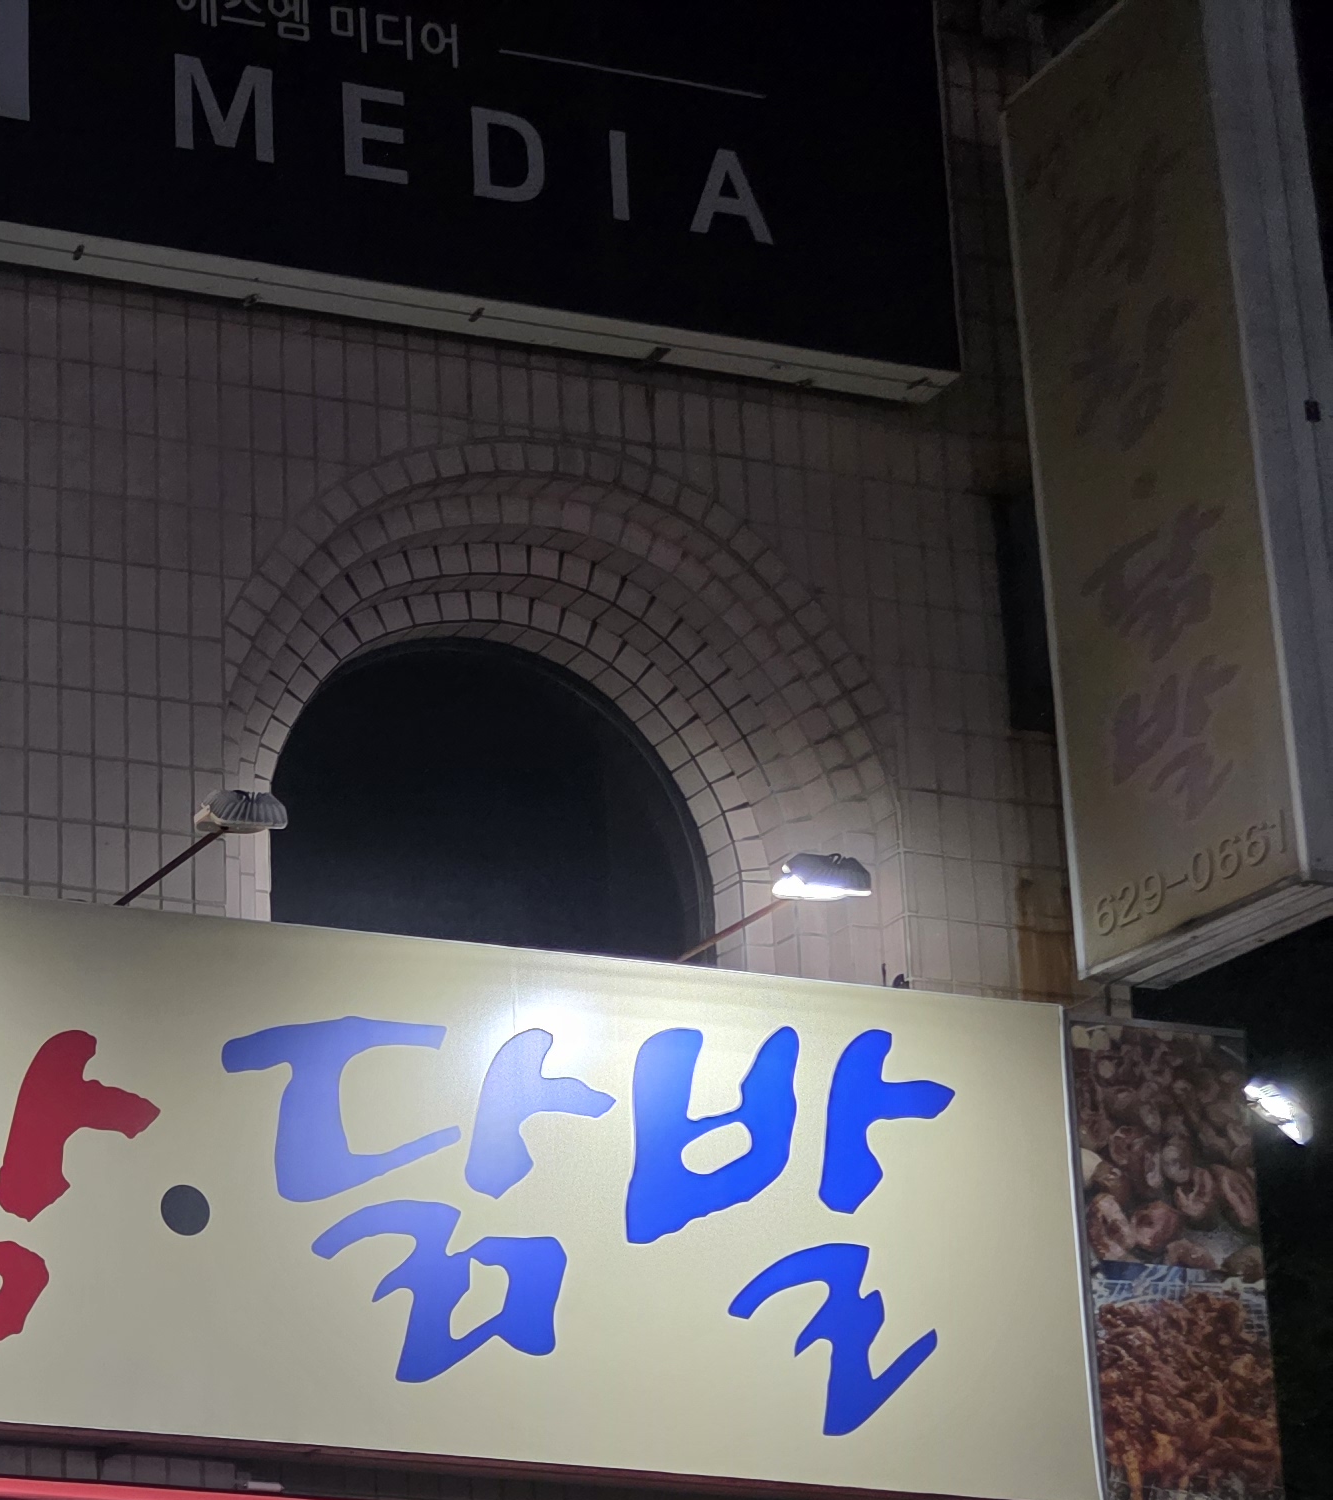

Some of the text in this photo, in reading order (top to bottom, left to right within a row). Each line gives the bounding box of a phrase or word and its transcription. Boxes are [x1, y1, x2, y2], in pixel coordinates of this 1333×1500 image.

[330, 7, 460, 69] 미디어
[174, 53, 774, 246] MEDIA
[1094, 808, 1288, 936] 629-0661
